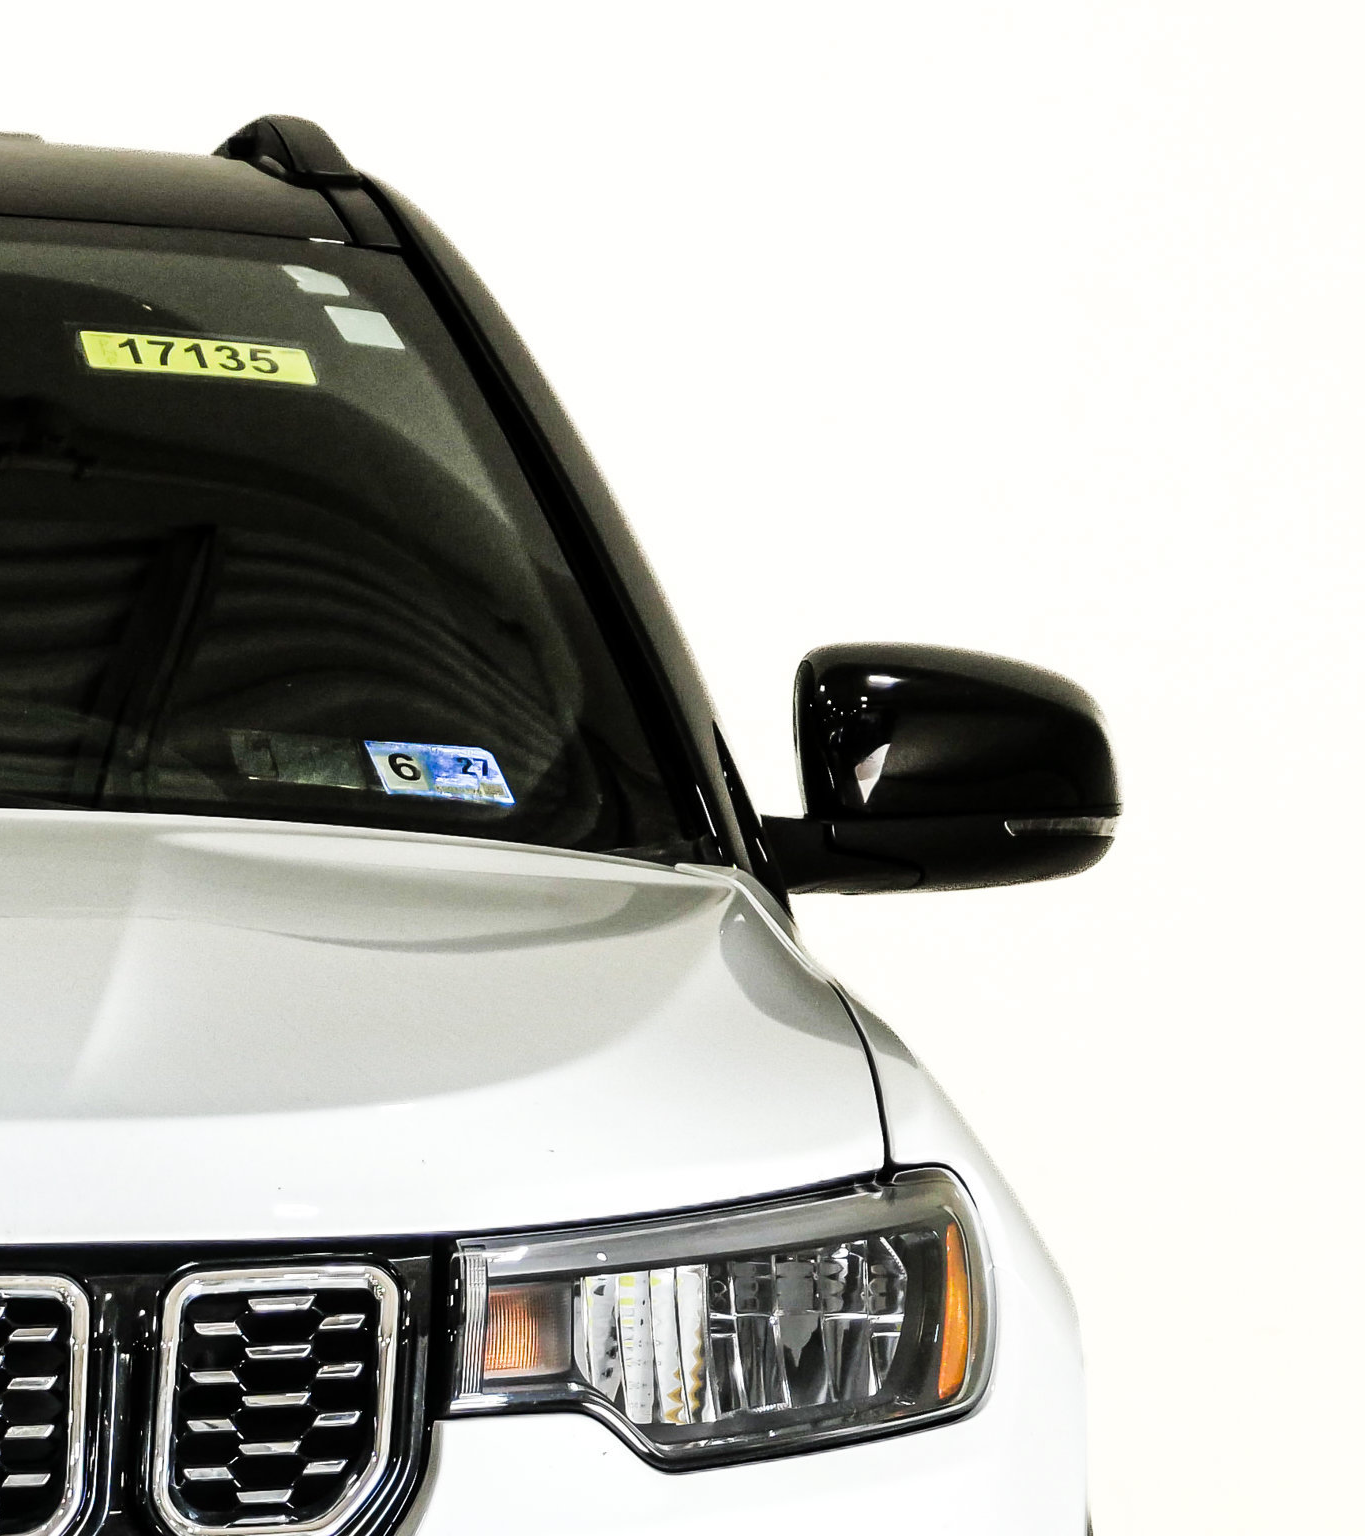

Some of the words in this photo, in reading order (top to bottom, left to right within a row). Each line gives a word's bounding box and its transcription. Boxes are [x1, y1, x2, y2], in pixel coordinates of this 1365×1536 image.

[118, 337, 279, 374] 17135
[388, 752, 421, 781] 6
[456, 756, 488, 777] 27
